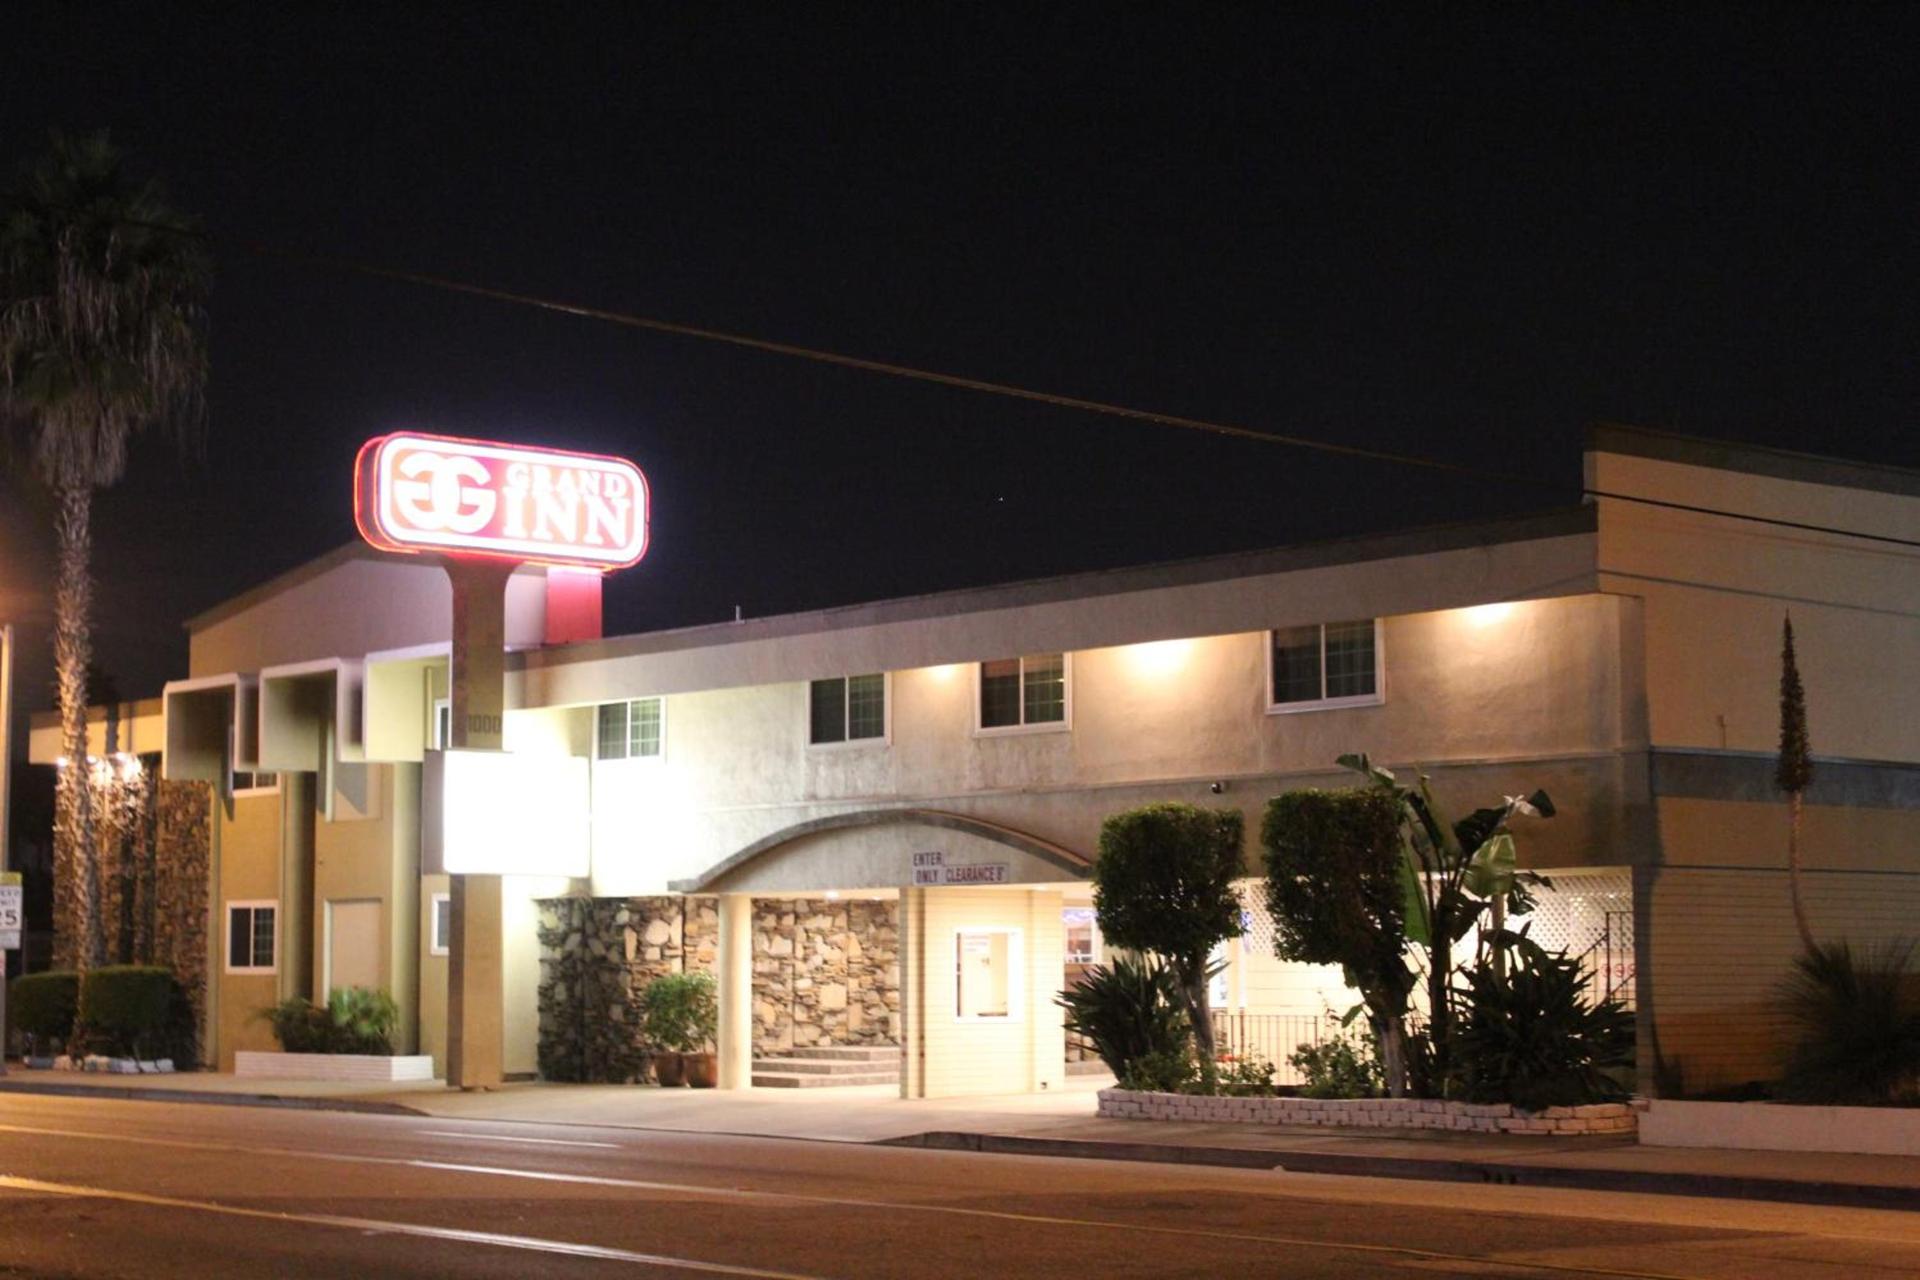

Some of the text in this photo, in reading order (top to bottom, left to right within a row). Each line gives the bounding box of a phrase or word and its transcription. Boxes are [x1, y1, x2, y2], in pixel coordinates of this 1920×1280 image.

[506, 461, 628, 499] GRAND
[502, 485, 632, 547] INN
[913, 852, 943, 867] ENTER
[916, 869, 939, 883] ONLY
[946, 867, 994, 882] CLEARANCE
[0, 908, 17, 926] 5
